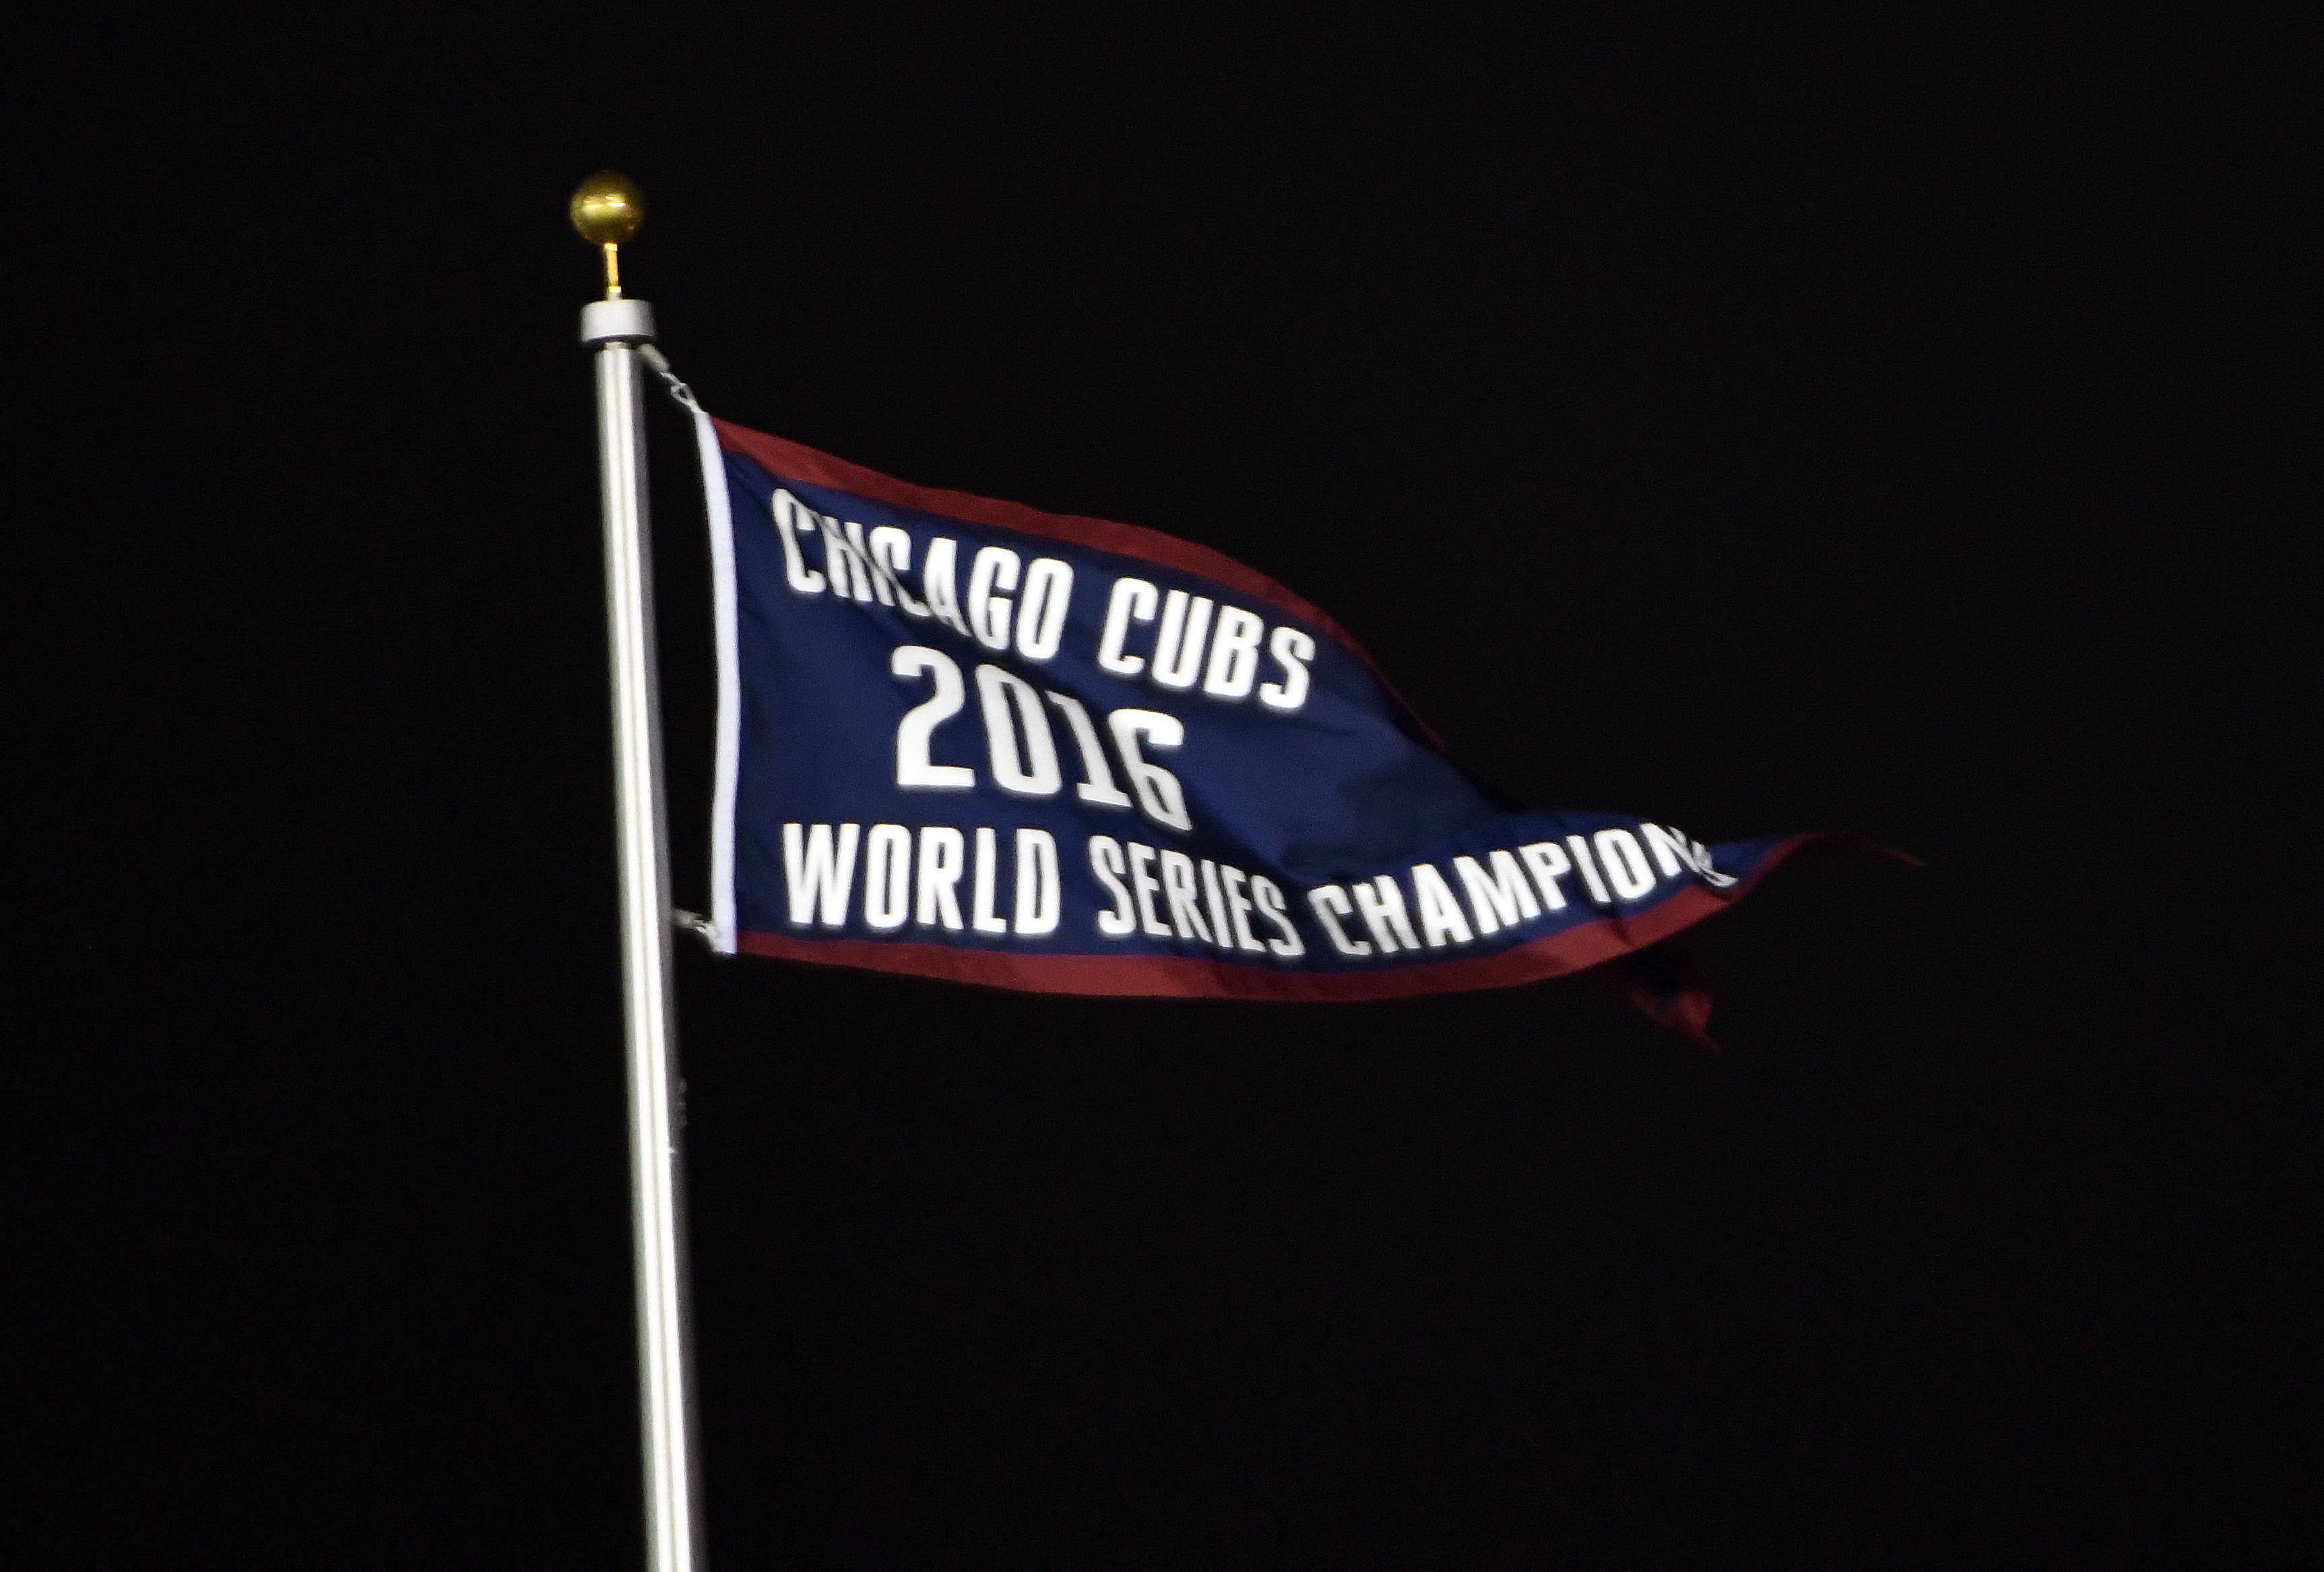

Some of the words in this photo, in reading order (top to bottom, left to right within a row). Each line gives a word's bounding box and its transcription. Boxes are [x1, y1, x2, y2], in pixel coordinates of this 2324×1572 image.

[771, 488, 1075, 662] CHICAGO
[1097, 577, 1316, 713] CUBS
[891, 645, 1192, 831] 2016
[781, 823, 1062, 939] WORLD
[1088, 835, 1305, 957] SERIES
